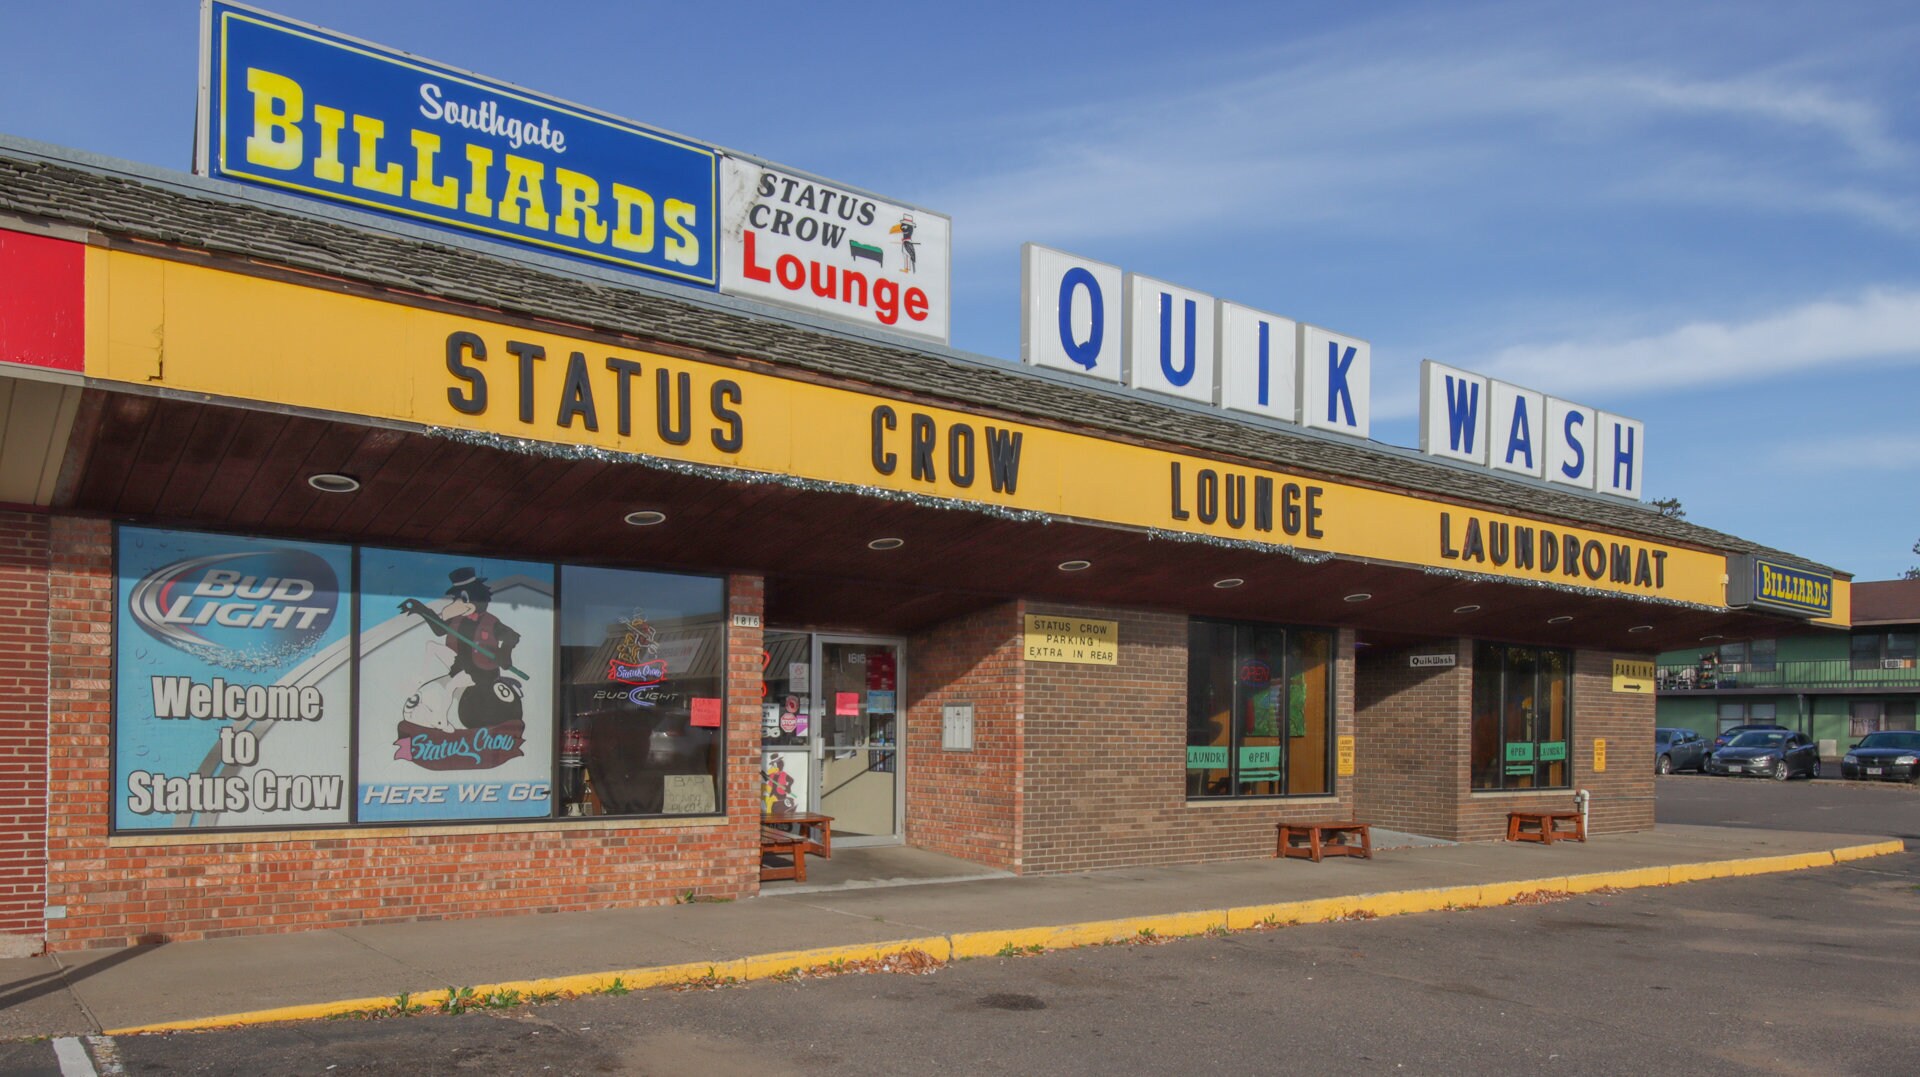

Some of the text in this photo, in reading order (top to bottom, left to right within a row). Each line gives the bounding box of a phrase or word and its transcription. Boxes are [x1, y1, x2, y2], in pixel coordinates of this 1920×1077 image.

[420, 83, 566, 153] Southgate
[247, 67, 700, 266] BILLIARDS
[757, 173, 876, 226] STATUS
[749, 204, 846, 249] CROW
[743, 229, 928, 325] Lounge
[1058, 267, 1634, 491] QUIK WASH
[446, 331, 1667, 588] STATUS CROW LOUNGE LAUNDROMAT
[193, 569, 314, 601] BUD
[1762, 565, 1828, 607] BILLIARDS
[164, 596, 330, 629] LIGHT
[735, 615, 759, 626] 1816
[1034, 620, 1107, 634] STATUS CROW
[1029, 646, 1063, 657] EXTRA
[1073, 650, 1083, 658] IN
[1046, 634, 1094, 647] PARKING
[1241, 665, 1270, 682] OPEN
[1615, 663, 1653, 678] PARKING
[151, 675, 323, 721] Welcome
[593, 690, 679, 701] BUD LIGHT
[219, 727, 259, 766] to
[411, 727, 515, 764] Status Crow
[1187, 752, 1226, 763] LAUNDRY
[1248, 751, 1270, 763] OPEN
[127, 768, 343, 815] Status Crow
[363, 784, 450, 806] HERE
[457, 783, 503, 804] WE
